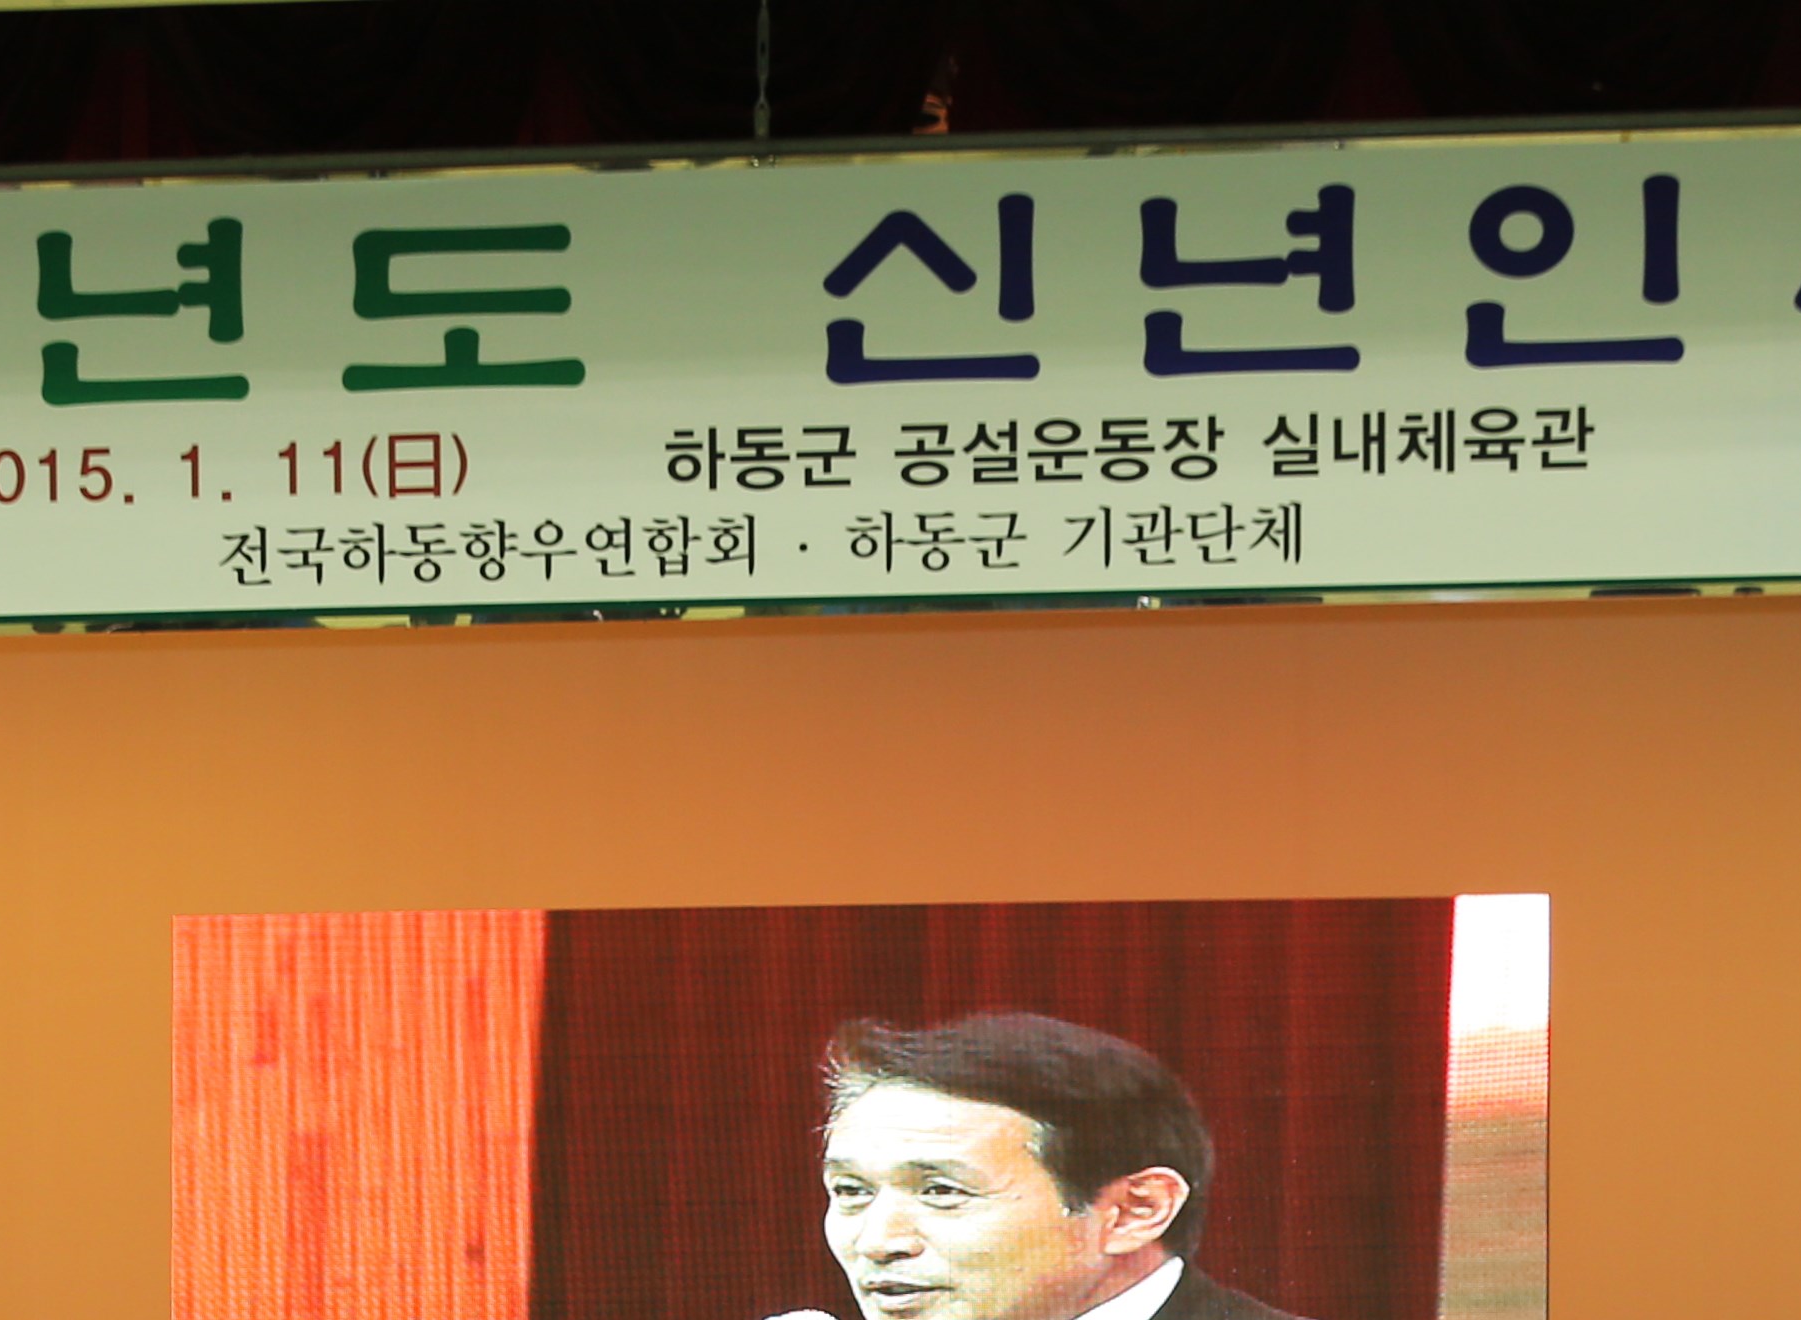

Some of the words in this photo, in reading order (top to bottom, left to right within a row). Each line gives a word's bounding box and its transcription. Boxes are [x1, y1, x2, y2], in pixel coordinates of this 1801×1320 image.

[183, 449, 231, 502] 1.
[278, 433, 470, 500] 11(日)
[663, 425, 859, 491] 하동군
[893, 415, 1226, 487] 공설운동장
[1262, 406, 1595, 478] 실내체육관
[221, 514, 759, 588] 전국하동향우연합회
[846, 511, 1027, 573] 하동군
[1063, 502, 1303, 568] 기관단체
